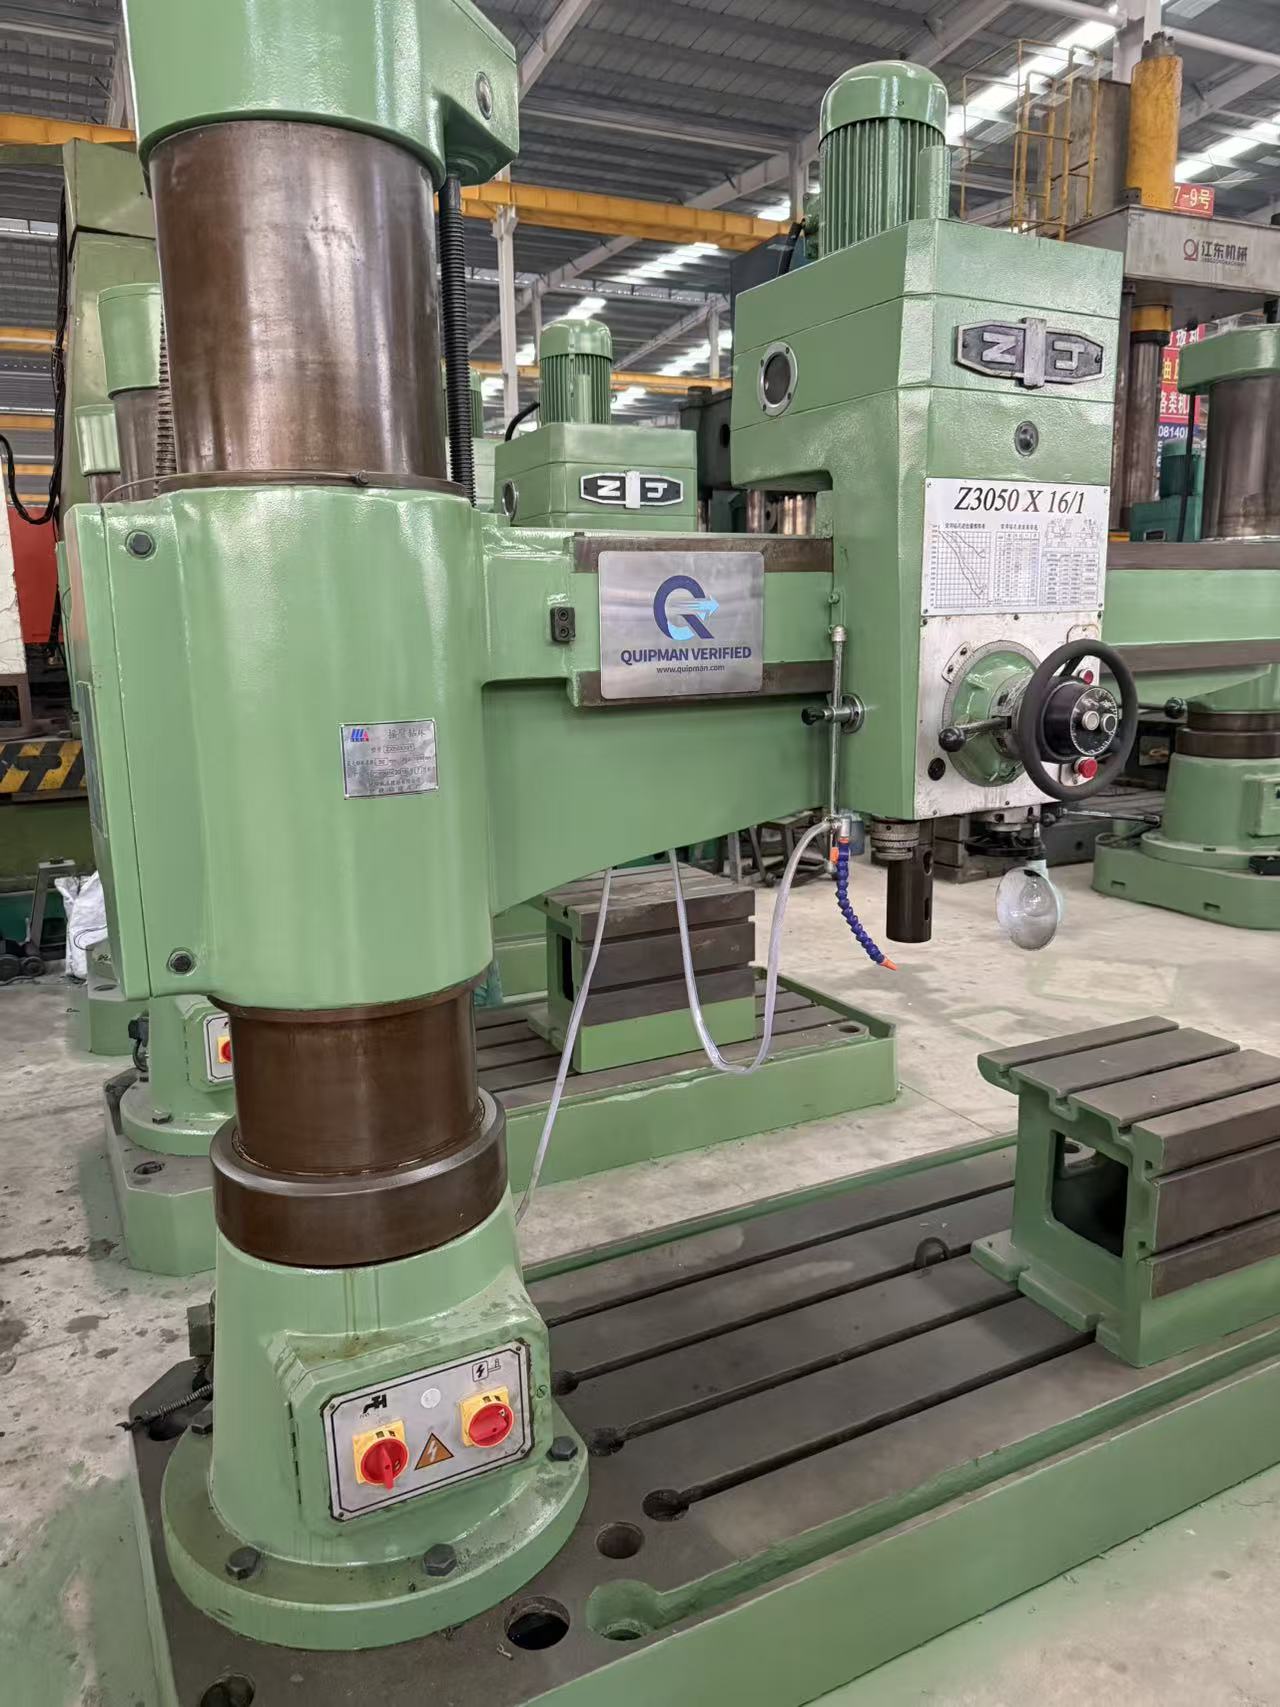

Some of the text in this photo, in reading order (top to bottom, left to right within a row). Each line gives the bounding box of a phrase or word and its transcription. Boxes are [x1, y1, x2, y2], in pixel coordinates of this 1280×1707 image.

[954, 486, 1020, 513] Z3050
[1047, 490, 1086, 515] 16/1
[620, 646, 752, 666] QUIPMAN VERIFIED
[656, 664, 725, 674] www.quipman.com
